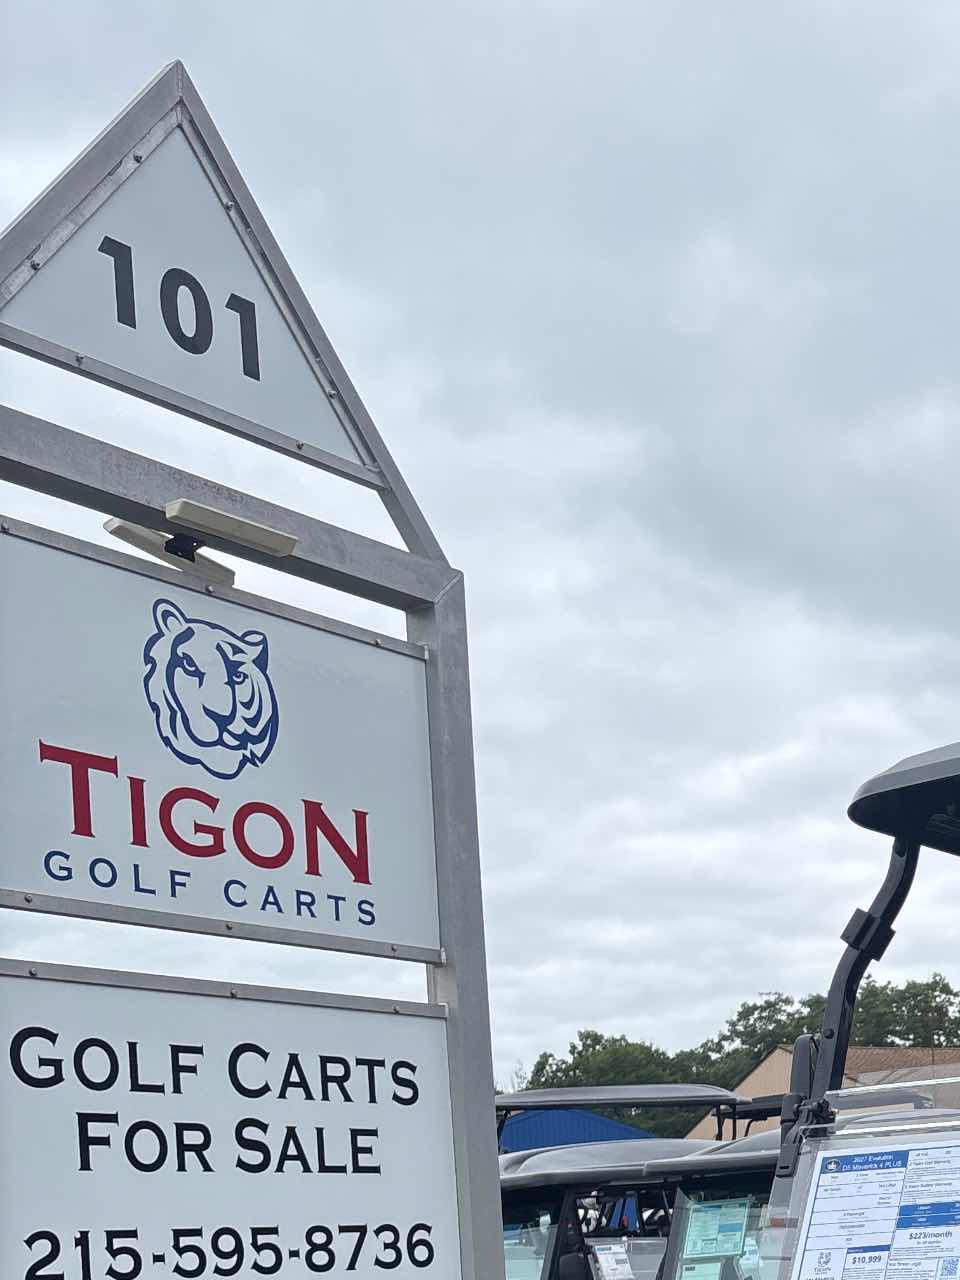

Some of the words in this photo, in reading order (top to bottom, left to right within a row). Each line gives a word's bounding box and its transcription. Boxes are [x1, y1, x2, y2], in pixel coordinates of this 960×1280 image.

[98, 236, 260, 381] 101
[40, 739, 371, 885] TIGON
[44, 851, 191, 898] GOLF
[224, 880, 376, 925] CARTS
[9, 1027, 204, 1095] GOLF
[228, 1043, 419, 1106] CARTS
[76, 1112, 214, 1173] FOR
[234, 1117, 381, 1174] SALE
[852, 1255, 882, 1265] $10,999
